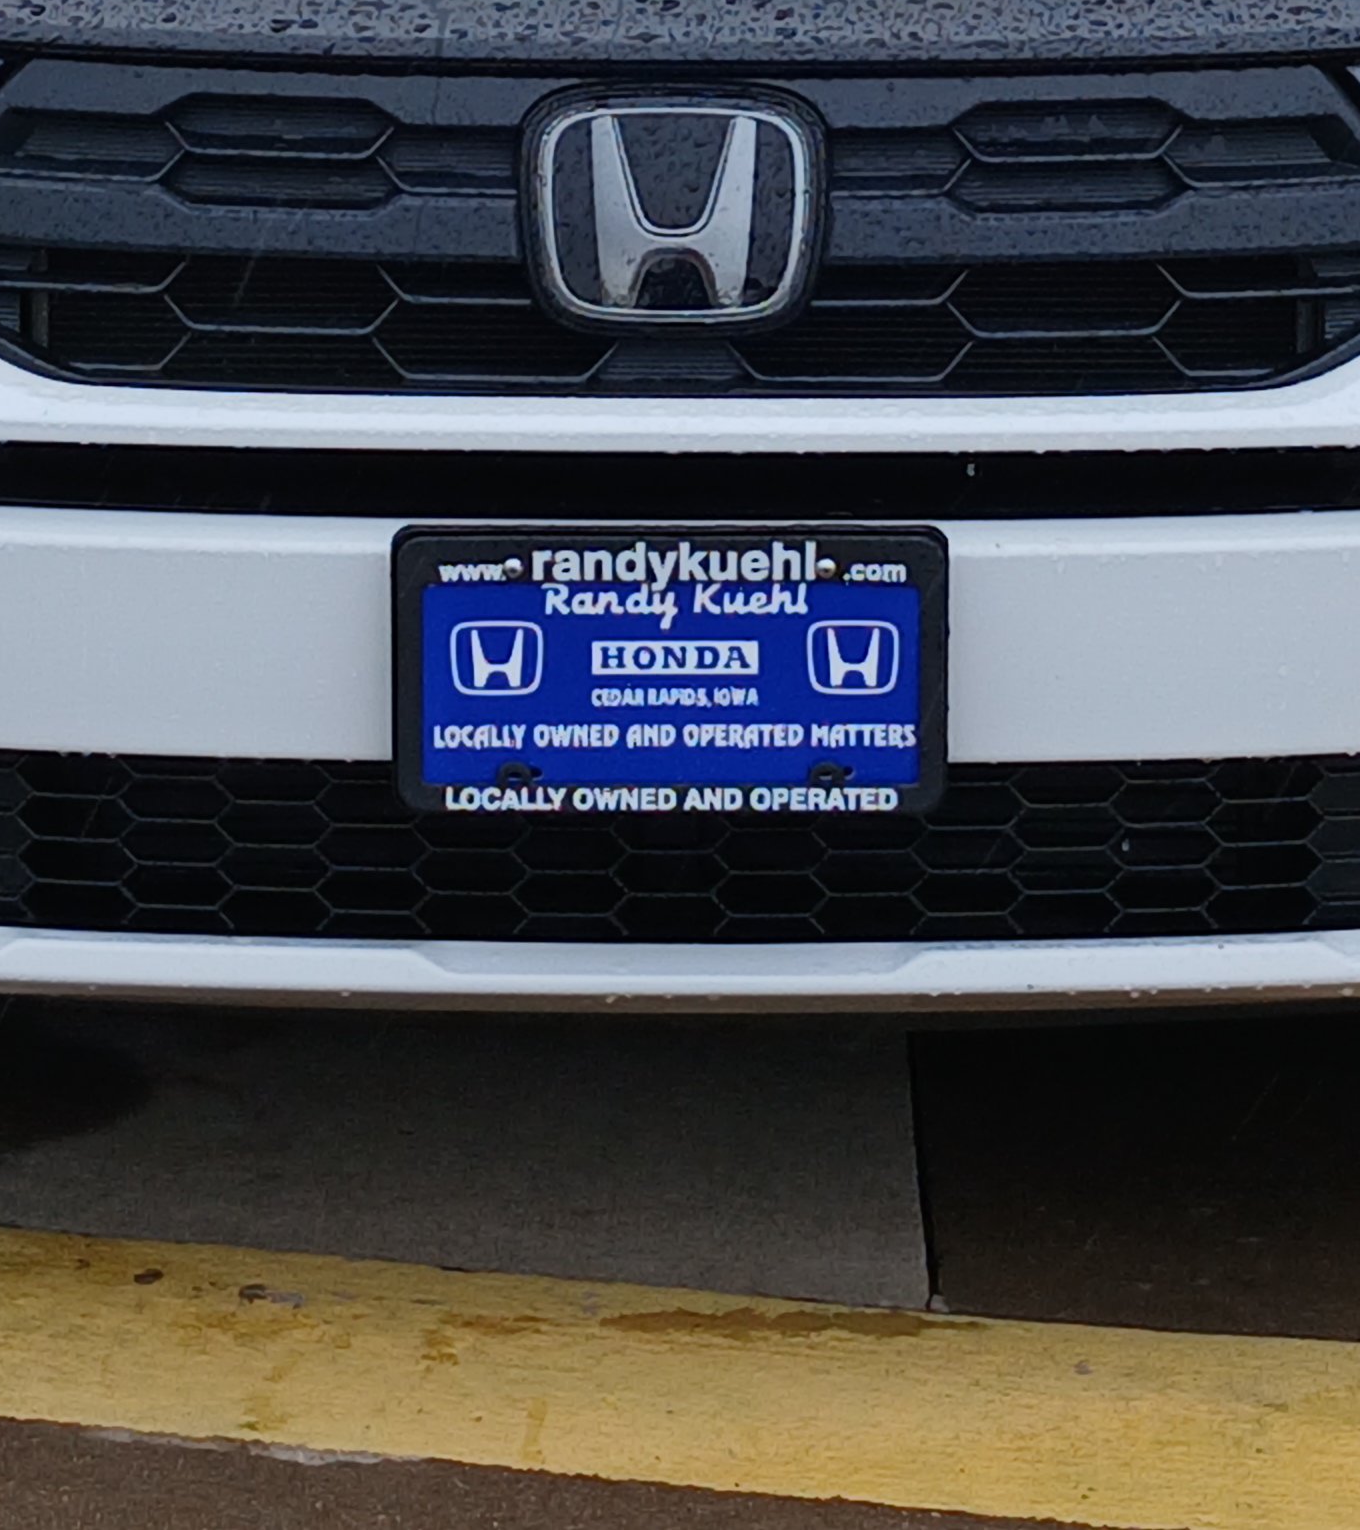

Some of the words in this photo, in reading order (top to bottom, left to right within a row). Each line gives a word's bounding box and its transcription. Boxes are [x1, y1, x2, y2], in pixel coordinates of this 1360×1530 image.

[532, 541, 817, 591] randykuehl
[842, 563, 907, 583] .com
[541, 582, 678, 630] Randy
[693, 583, 808, 614] Kuehl
[599, 645, 752, 670] HONDA
[591, 687, 645, 707] CEDAR
[713, 685, 760, 707] IOWA
[433, 724, 527, 750] LOCALLY
[533, 724, 620, 748] OWNED
[626, 723, 677, 749] AND
[682, 723, 805, 749] OPERATED
[811, 723, 917, 749] MATTERS
[445, 786, 566, 811] LOCALLY
[572, 786, 678, 811] OWNED
[683, 787, 744, 811] AND
[749, 787, 899, 811] OPERATED
